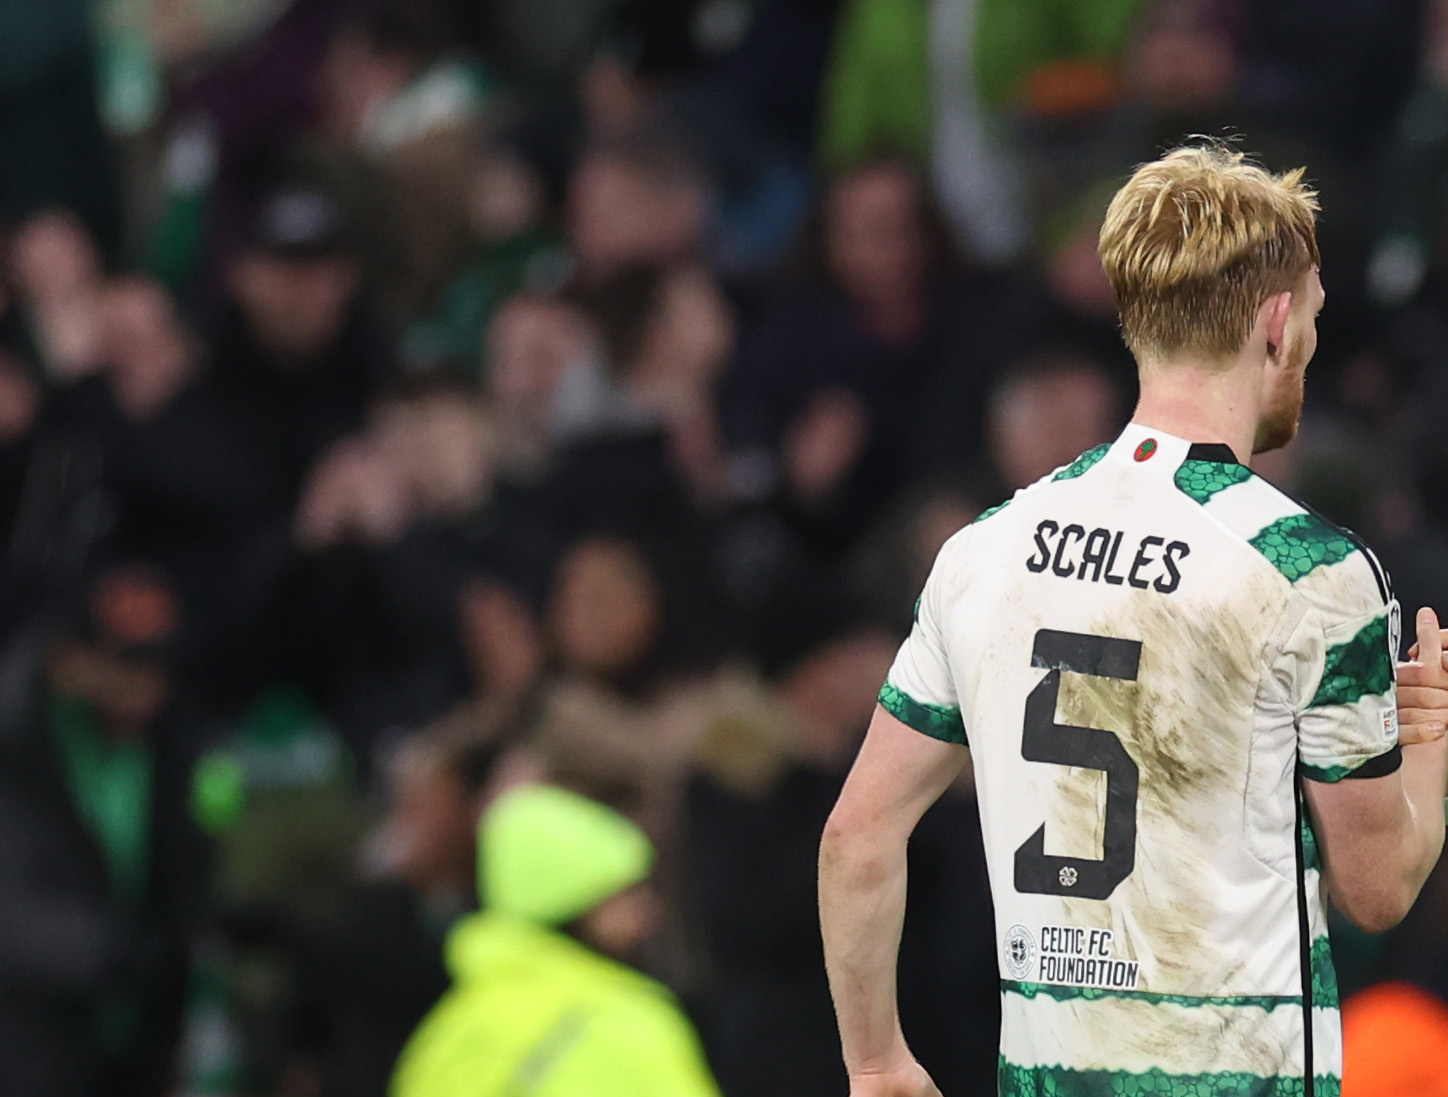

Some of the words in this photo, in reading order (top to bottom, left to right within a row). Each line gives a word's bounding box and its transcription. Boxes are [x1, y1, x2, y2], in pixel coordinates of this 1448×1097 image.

[1026, 519, 1190, 594] SCALES
[1014, 628, 1142, 900] 5
[1041, 926, 1084, 955] CELTIC
[1088, 930, 1112, 957] FC
[1040, 955, 1139, 987] FOUNDATION
